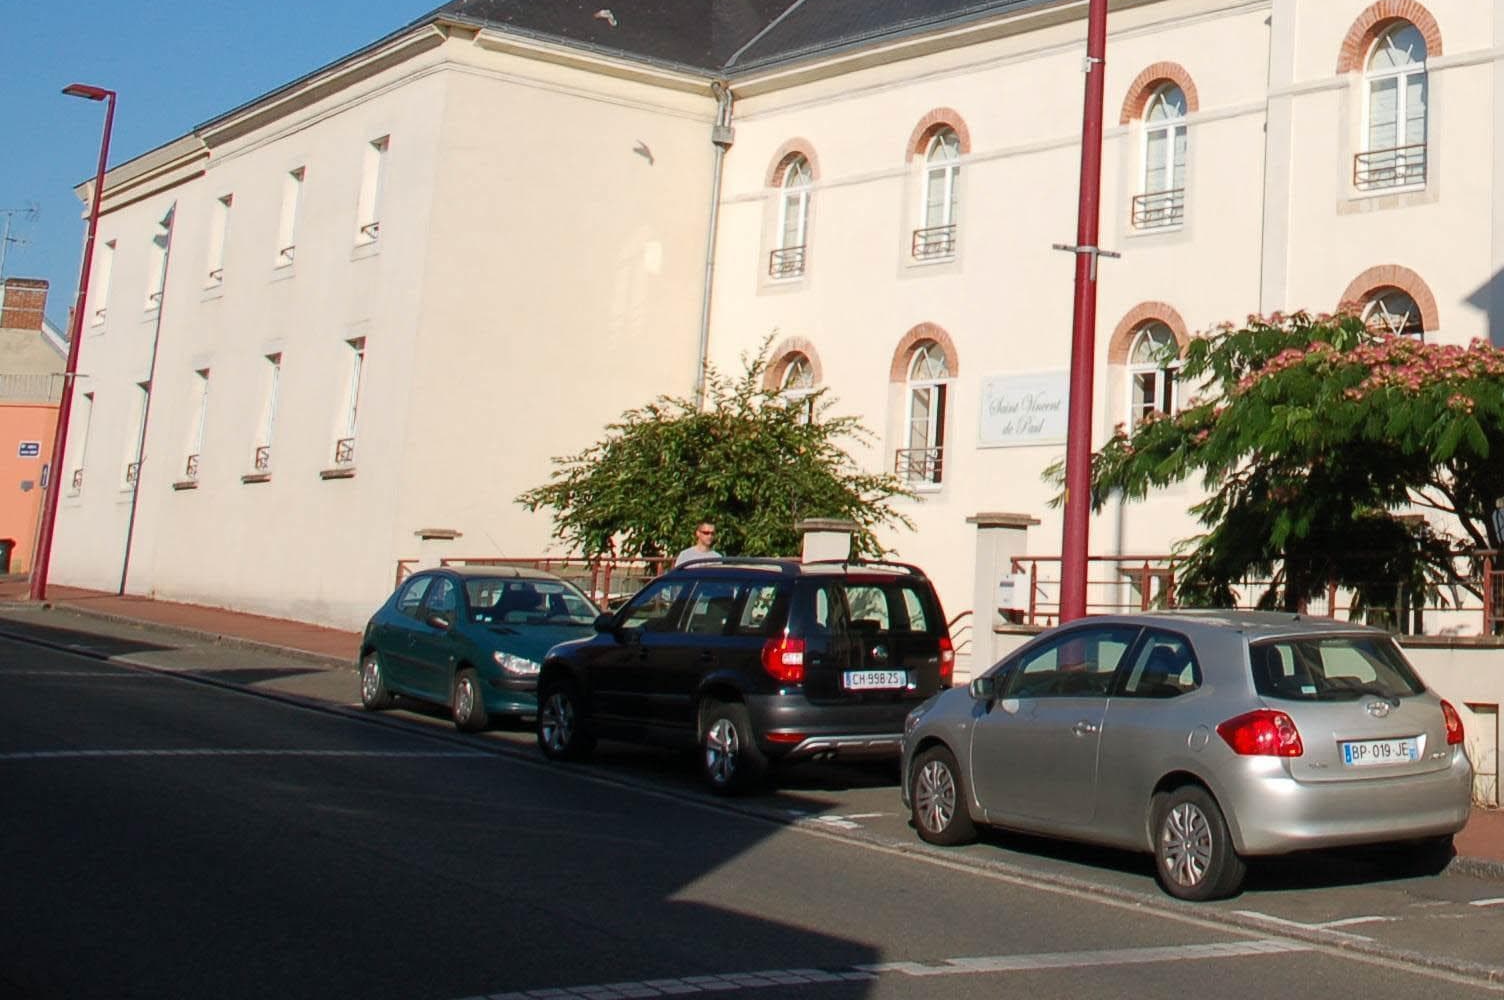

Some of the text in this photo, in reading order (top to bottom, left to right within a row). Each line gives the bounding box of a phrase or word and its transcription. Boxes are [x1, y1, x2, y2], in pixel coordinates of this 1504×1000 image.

[988, 392, 1061, 415] Saint Vincent
[1002, 420, 1015, 435] de
